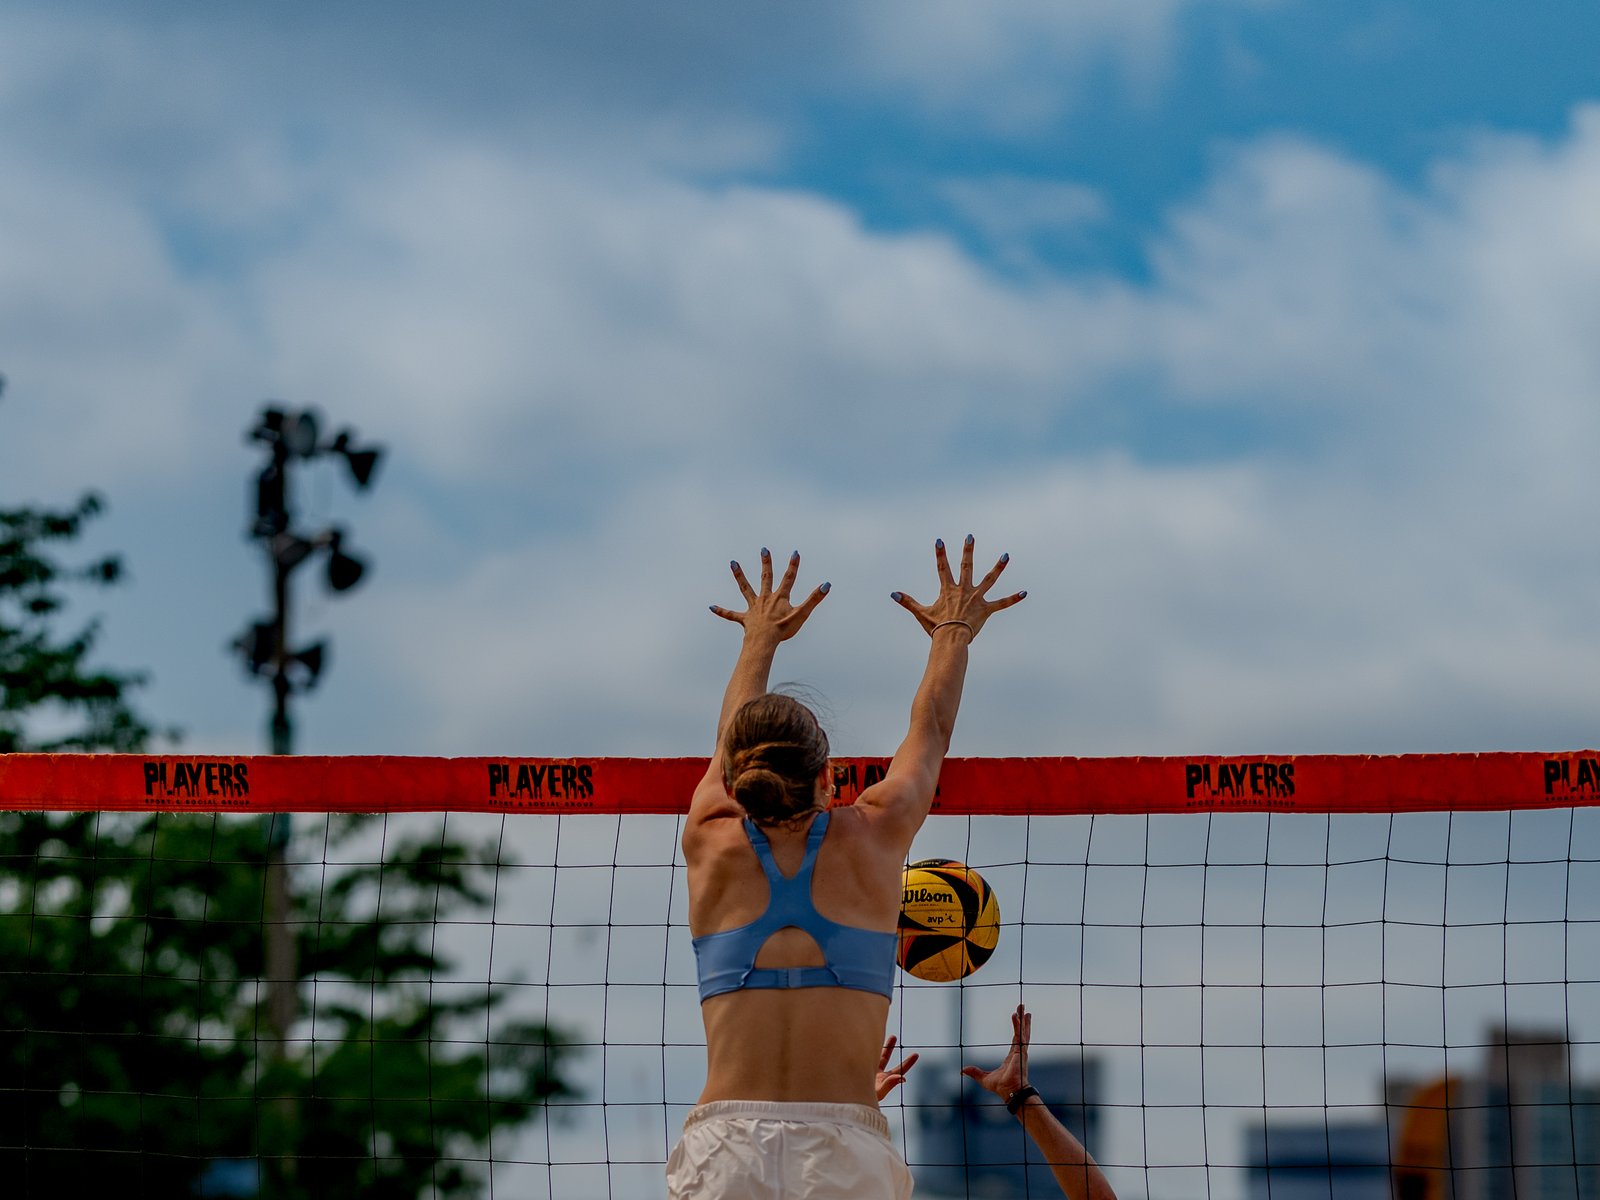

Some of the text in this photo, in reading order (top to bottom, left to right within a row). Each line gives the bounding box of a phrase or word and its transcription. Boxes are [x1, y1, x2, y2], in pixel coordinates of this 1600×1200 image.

[143, 762, 249, 797] PLAYERS
[488, 764, 594, 799] PLAYERS
[1185, 763, 1295, 798] PLAYERS
[927, 916, 944, 925] avp
